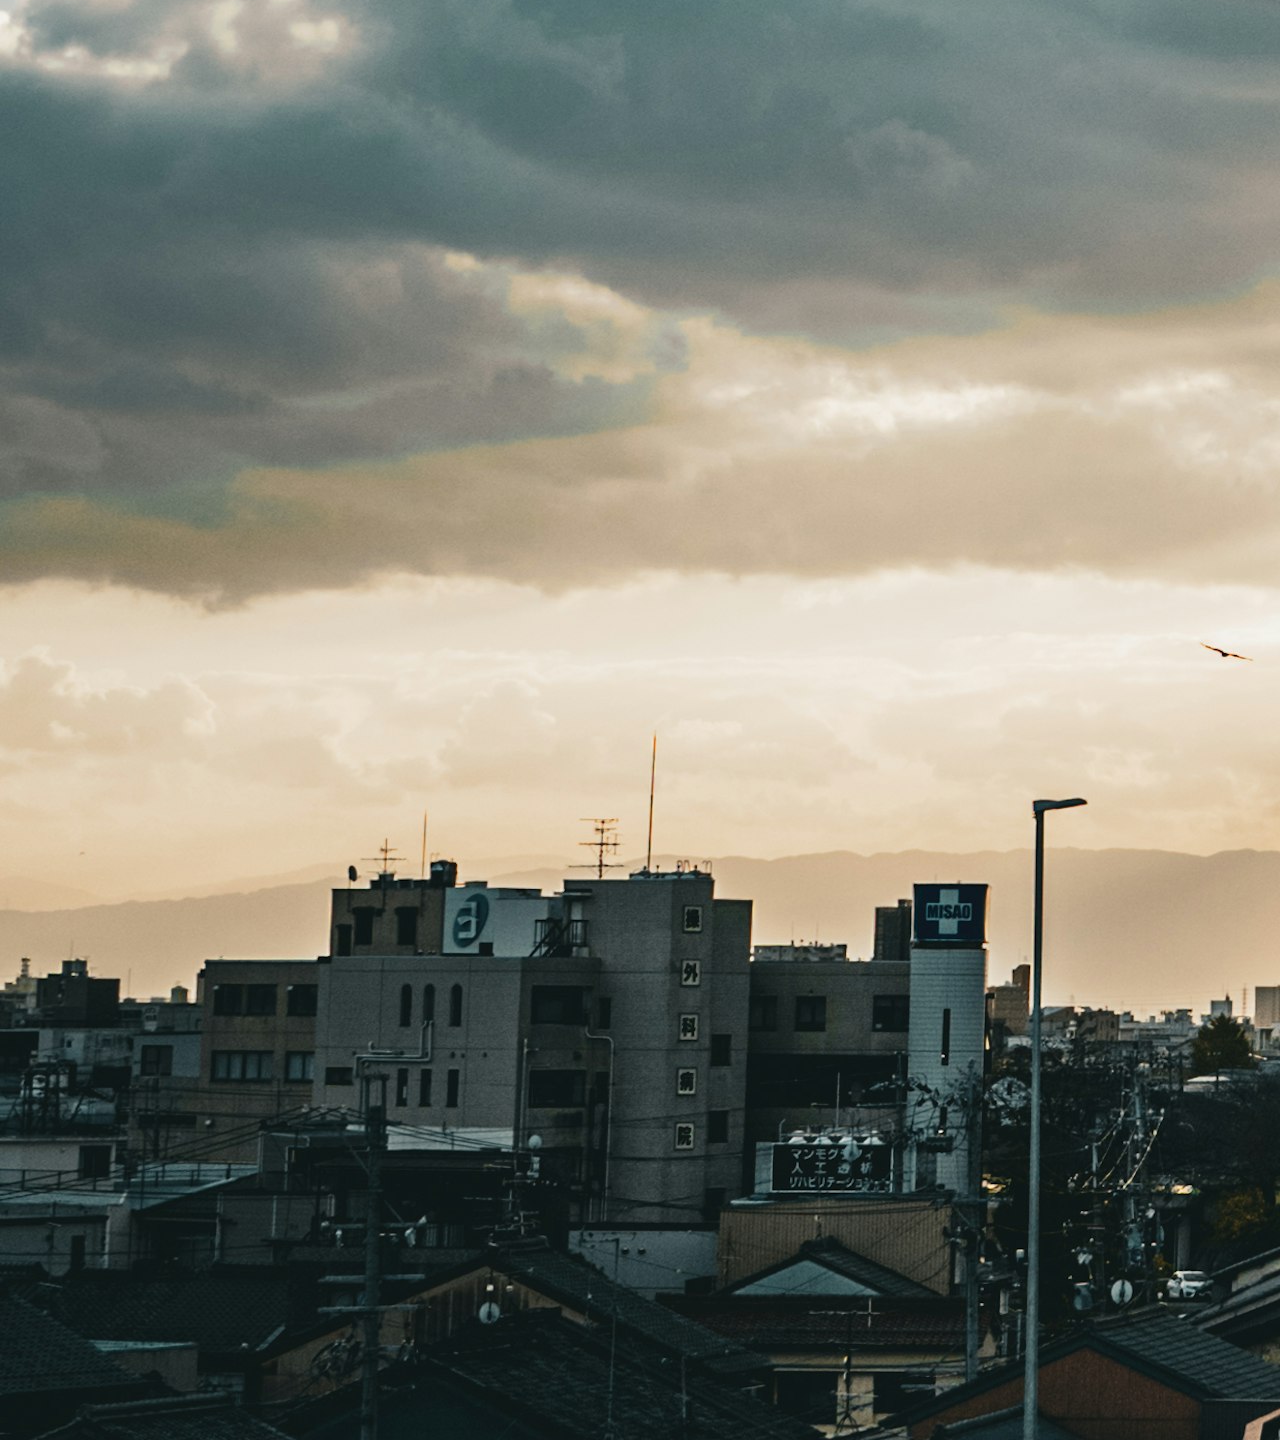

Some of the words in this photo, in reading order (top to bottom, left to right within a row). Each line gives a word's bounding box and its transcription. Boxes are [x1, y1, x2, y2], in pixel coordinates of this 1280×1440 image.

[927, 906, 971, 919] MISAO
[676, 908, 701, 1146] 操外科病院
